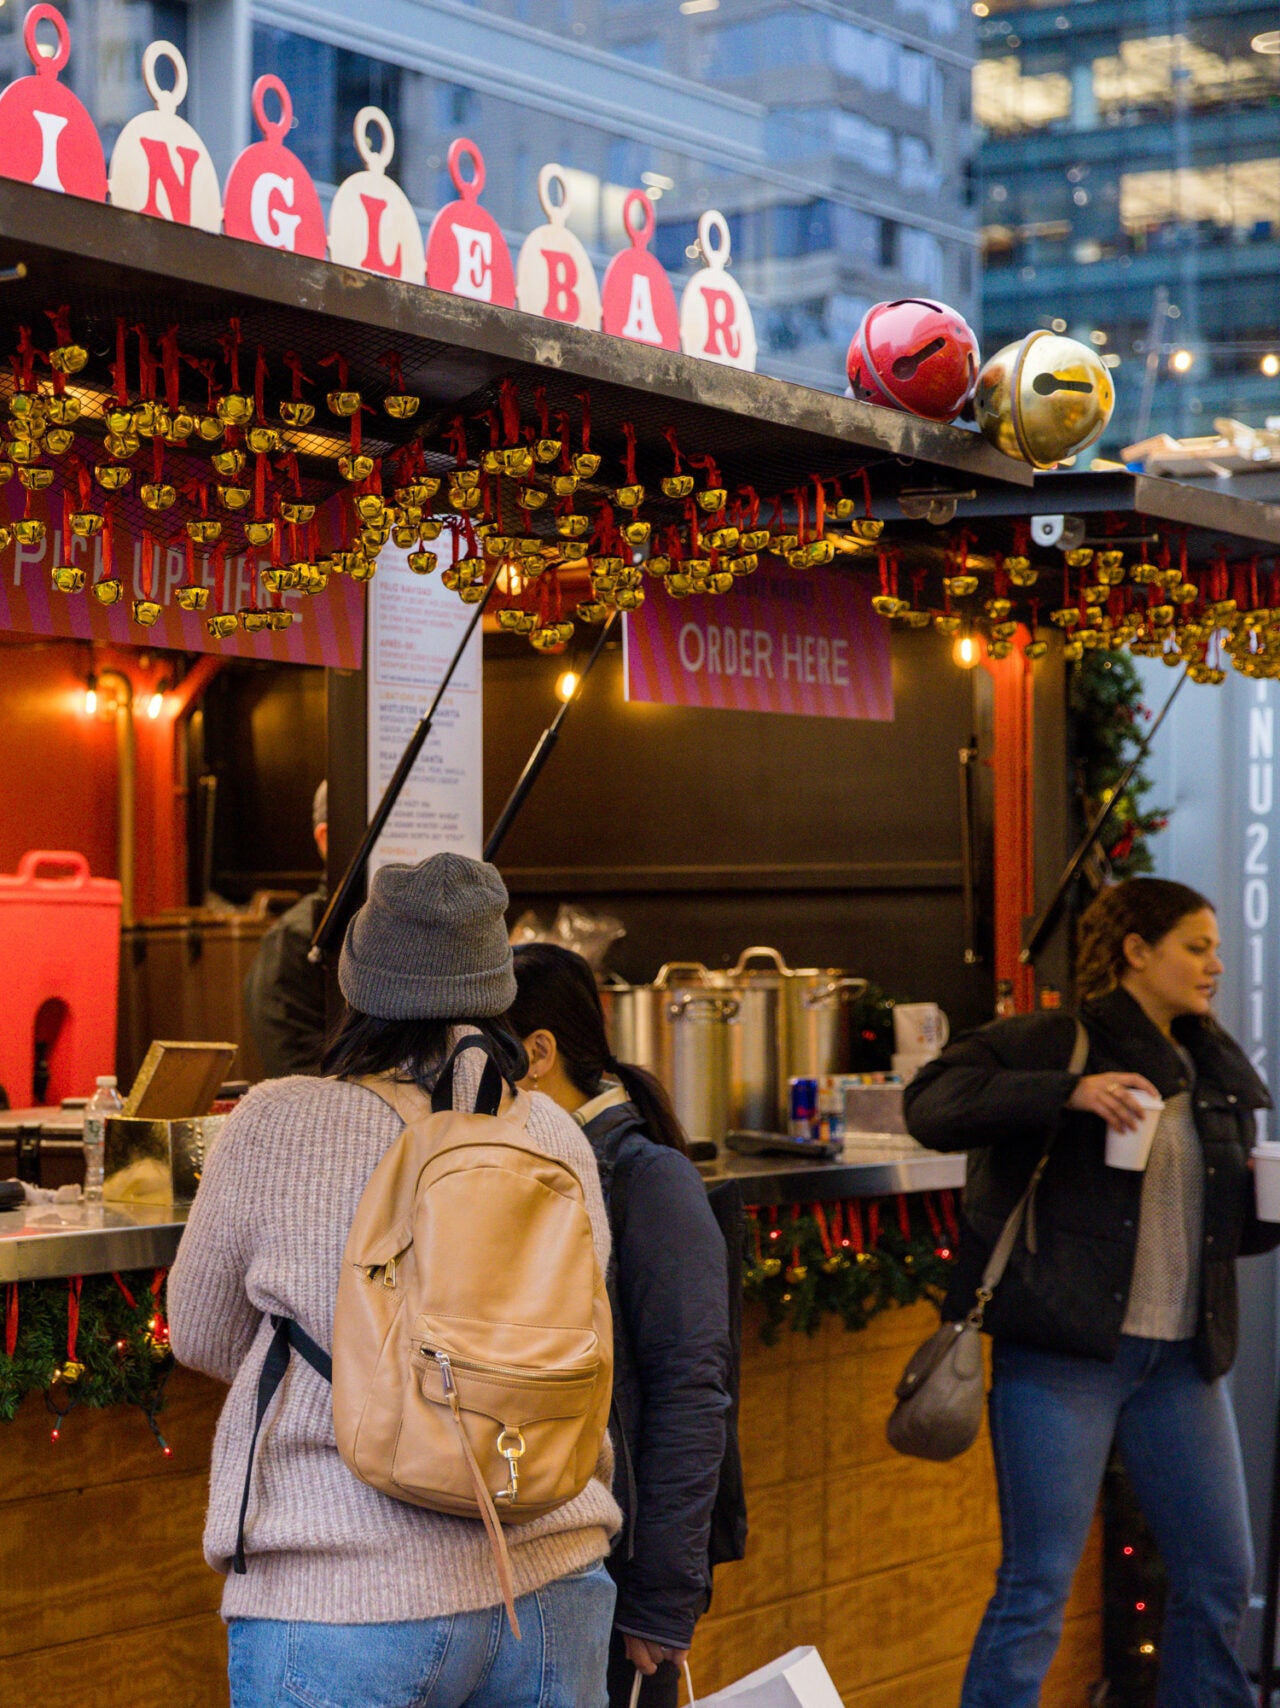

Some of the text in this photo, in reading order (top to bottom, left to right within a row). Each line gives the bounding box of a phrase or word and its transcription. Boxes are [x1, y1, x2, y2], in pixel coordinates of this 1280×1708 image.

[133, 541, 184, 607] UP
[679, 622, 850, 687] ORDER HERE
